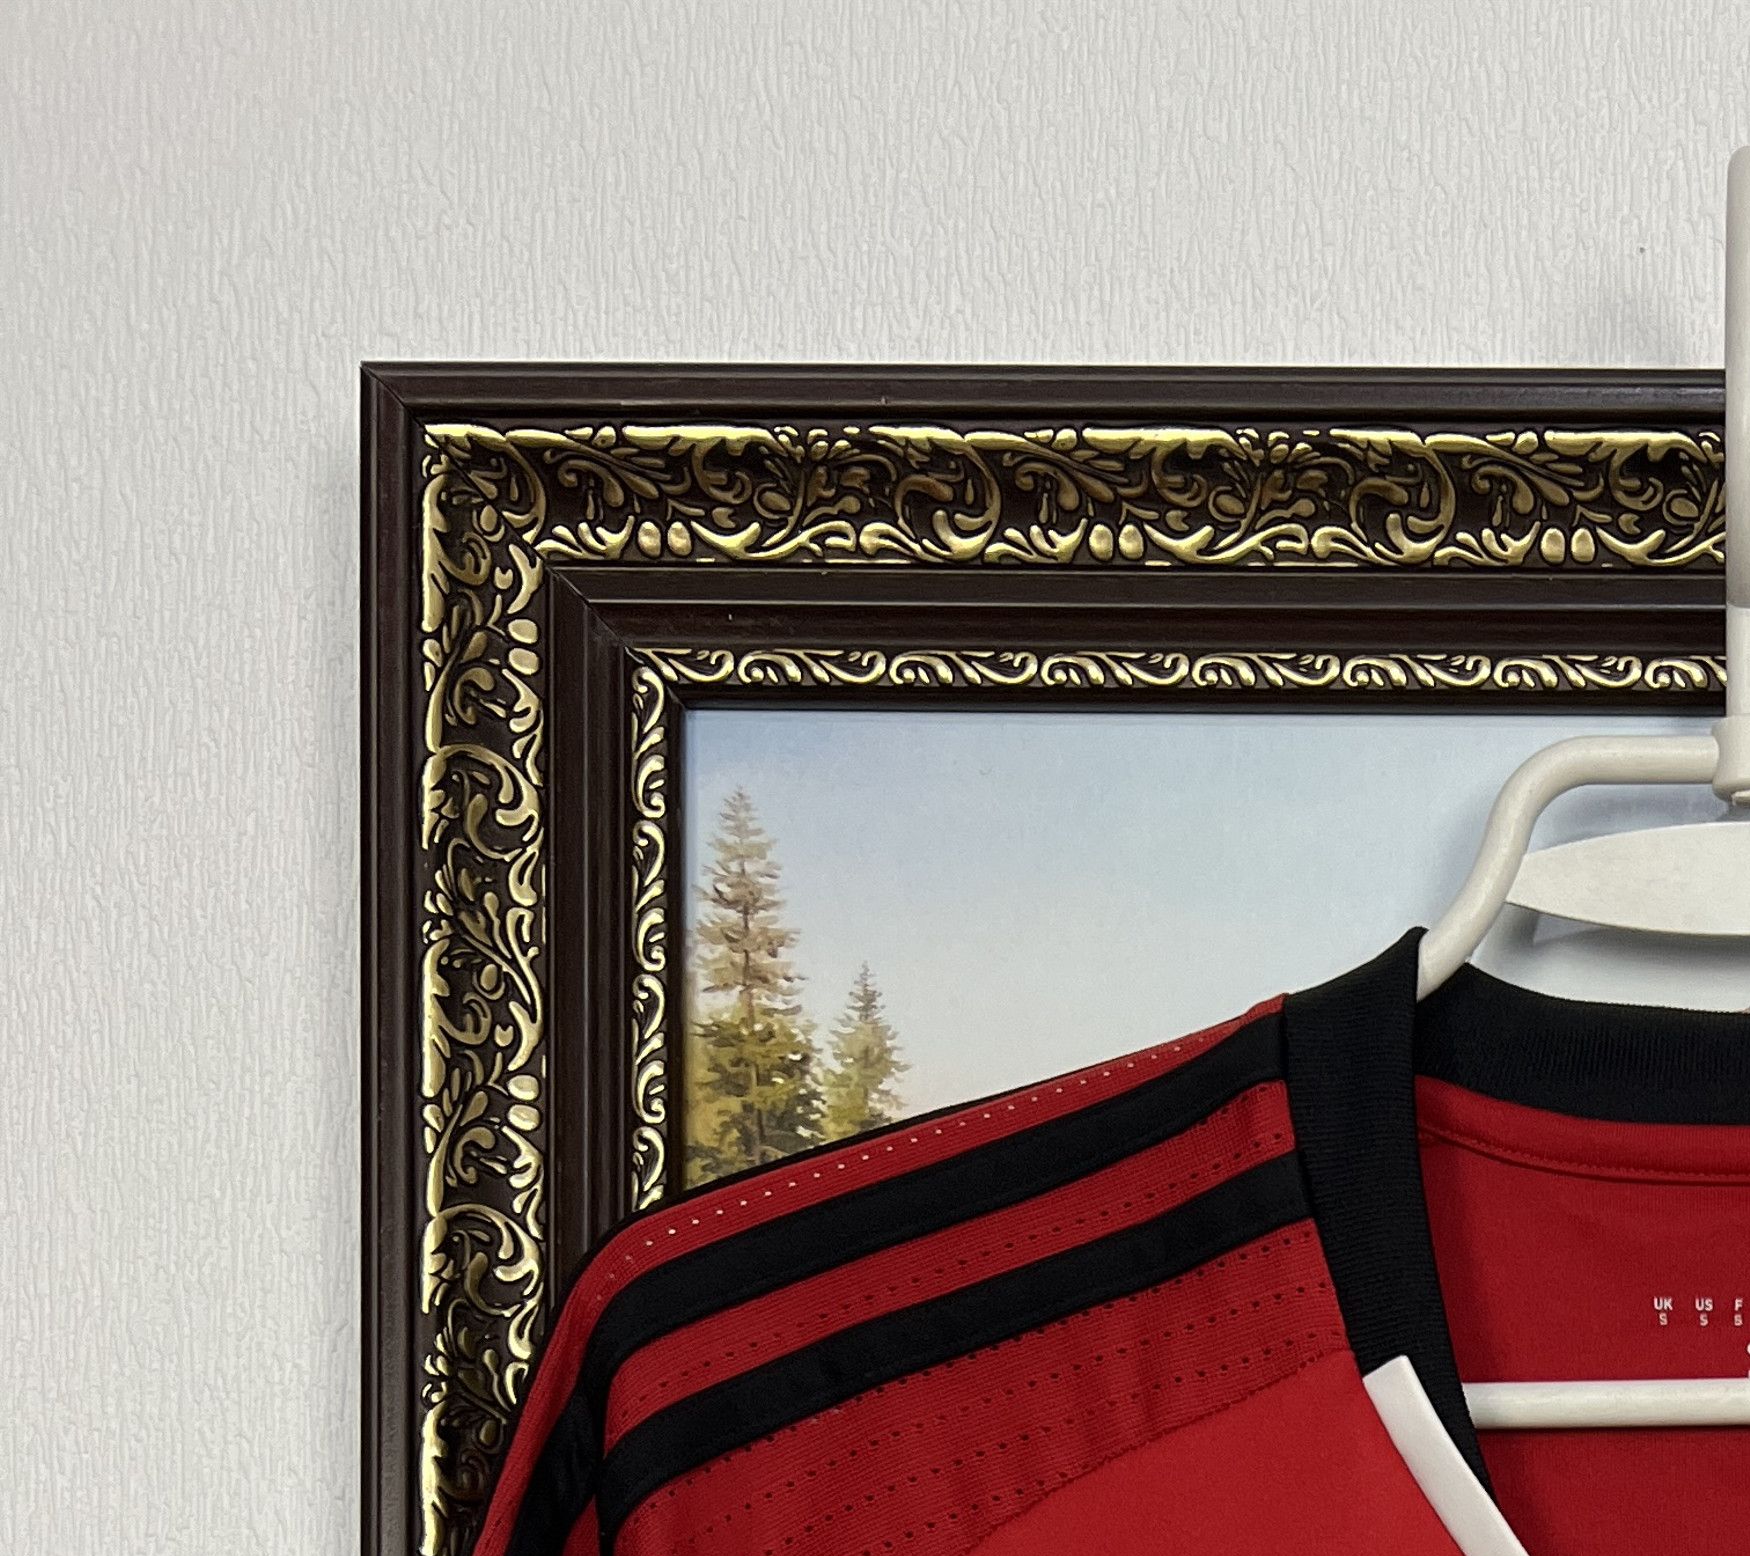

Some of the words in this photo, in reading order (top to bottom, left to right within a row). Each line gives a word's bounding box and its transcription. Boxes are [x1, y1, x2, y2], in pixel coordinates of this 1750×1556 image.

[1653, 1297, 1673, 1311] UK
[1695, 1298, 1714, 1312] US
[1734, 1298, 1743, 1311] F
[1659, 1312, 1668, 1326] S
[1700, 1313, 1709, 1327] S
